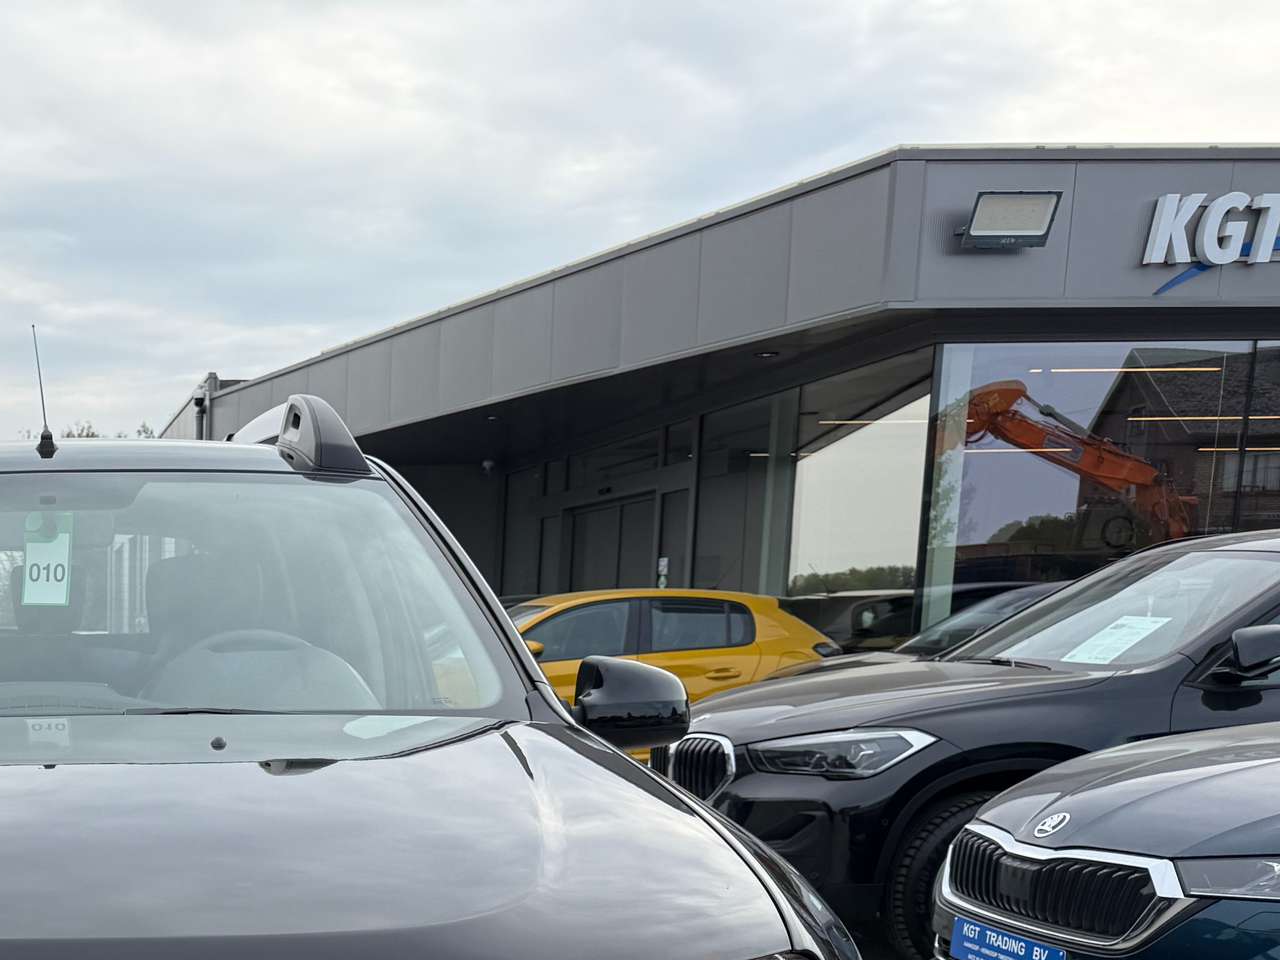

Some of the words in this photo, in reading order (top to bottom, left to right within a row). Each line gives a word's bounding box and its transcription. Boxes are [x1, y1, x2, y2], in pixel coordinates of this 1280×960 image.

[29, 563, 66, 583] 010
[962, 922, 980, 940] KGT
[985, 930, 1026, 956] TRADING
